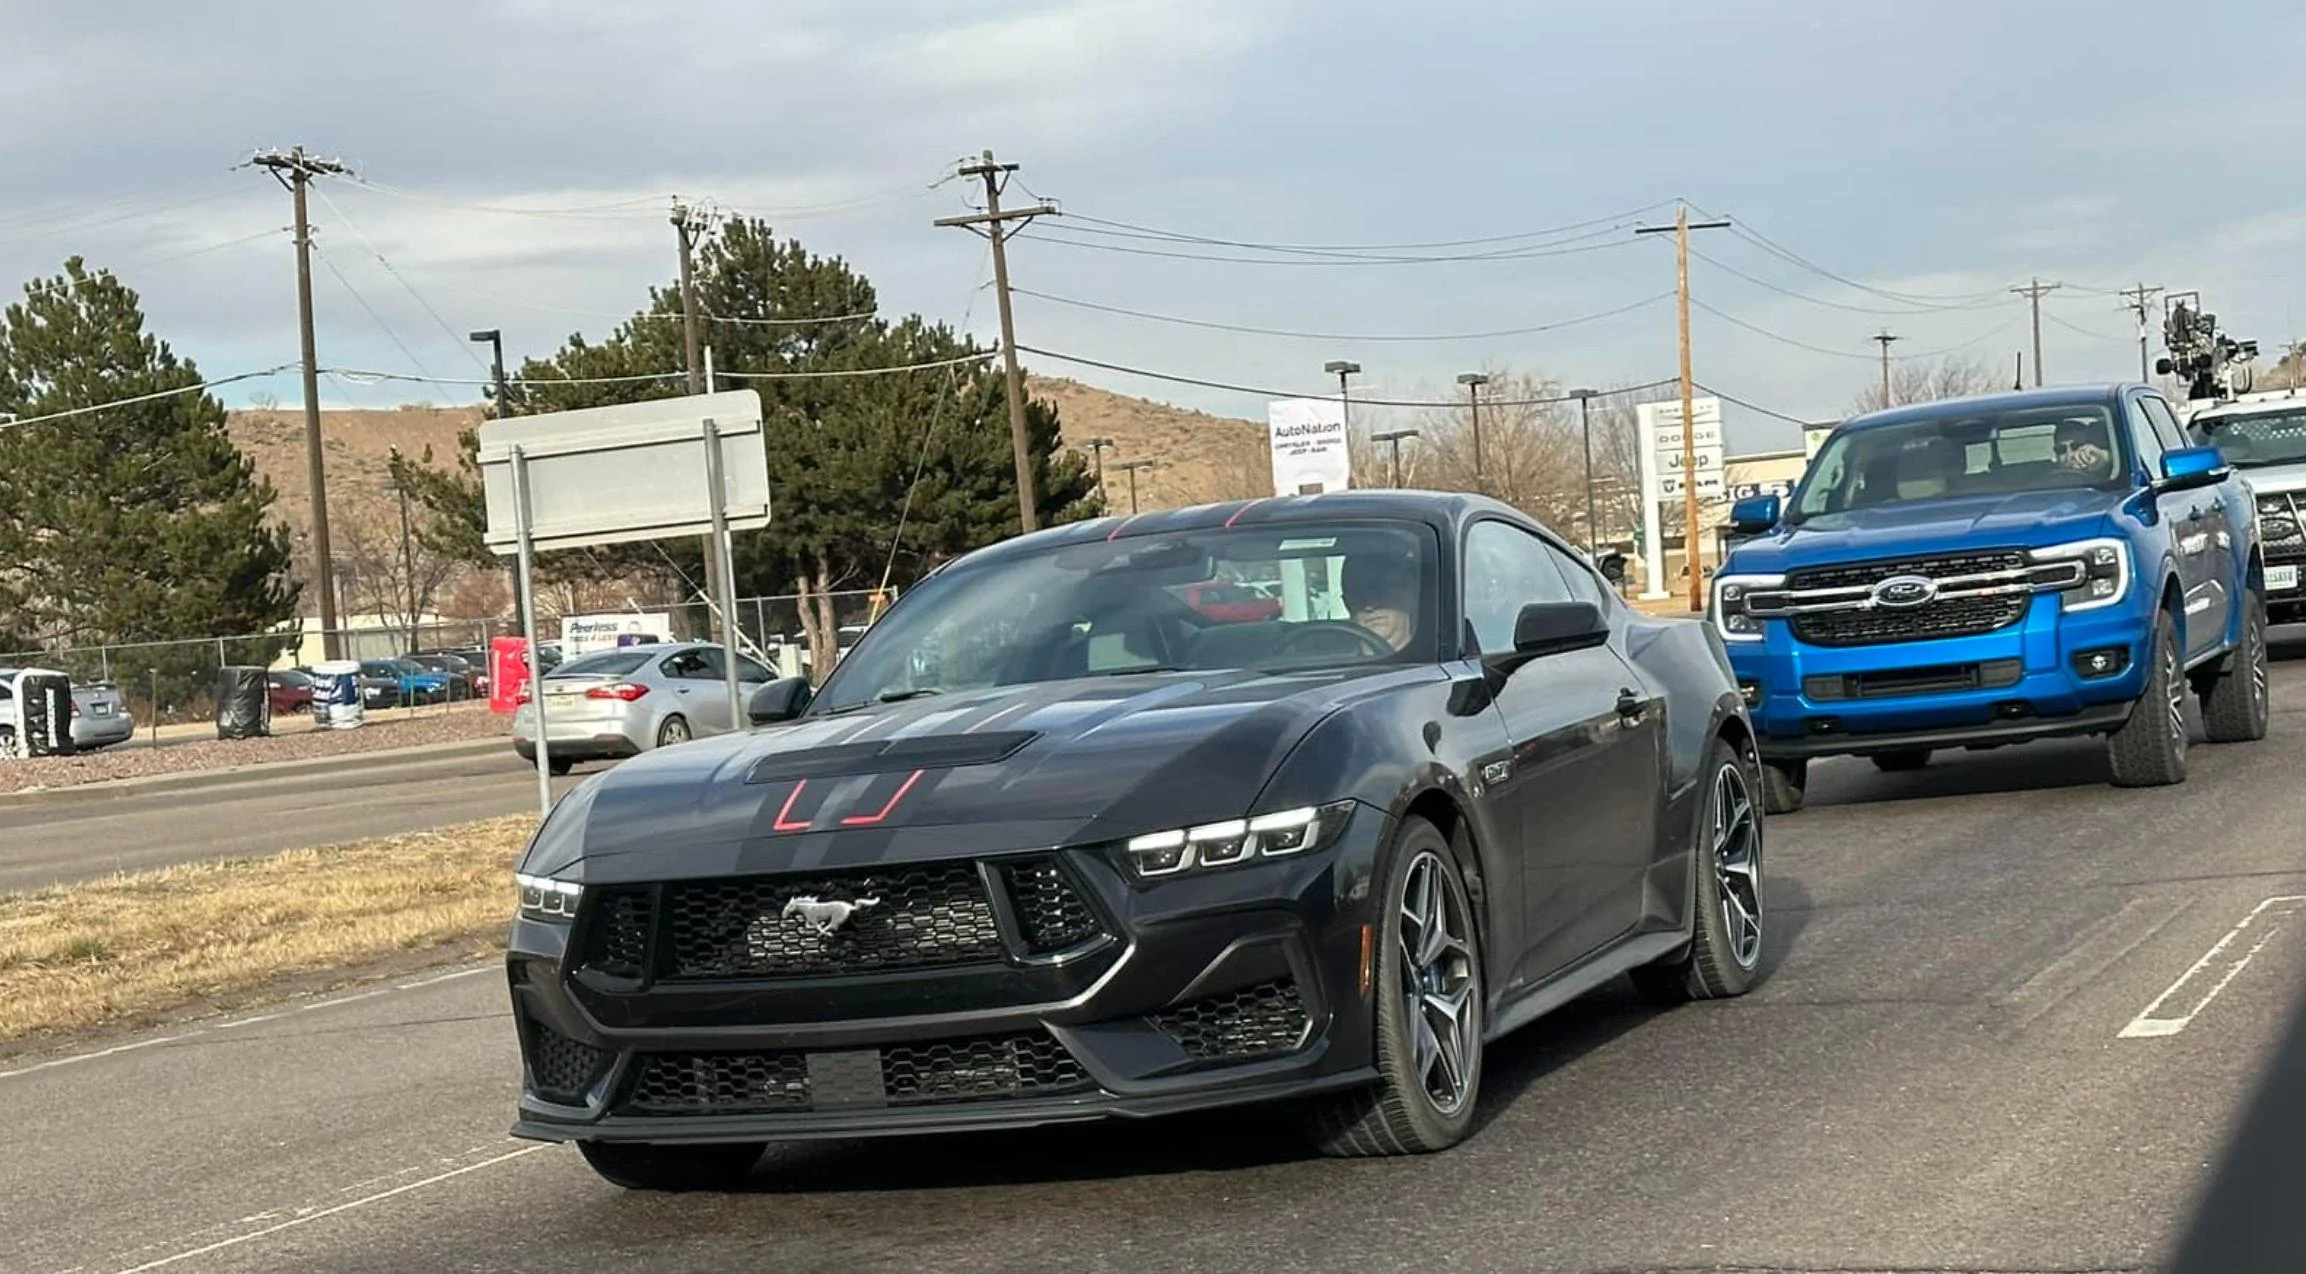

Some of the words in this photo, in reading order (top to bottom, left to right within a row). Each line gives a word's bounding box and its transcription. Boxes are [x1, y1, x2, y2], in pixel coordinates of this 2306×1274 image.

[1275, 423, 1341, 437] AutoNation
[1658, 431, 1716, 443] DOGE
[569, 621, 618, 634] Peerless
